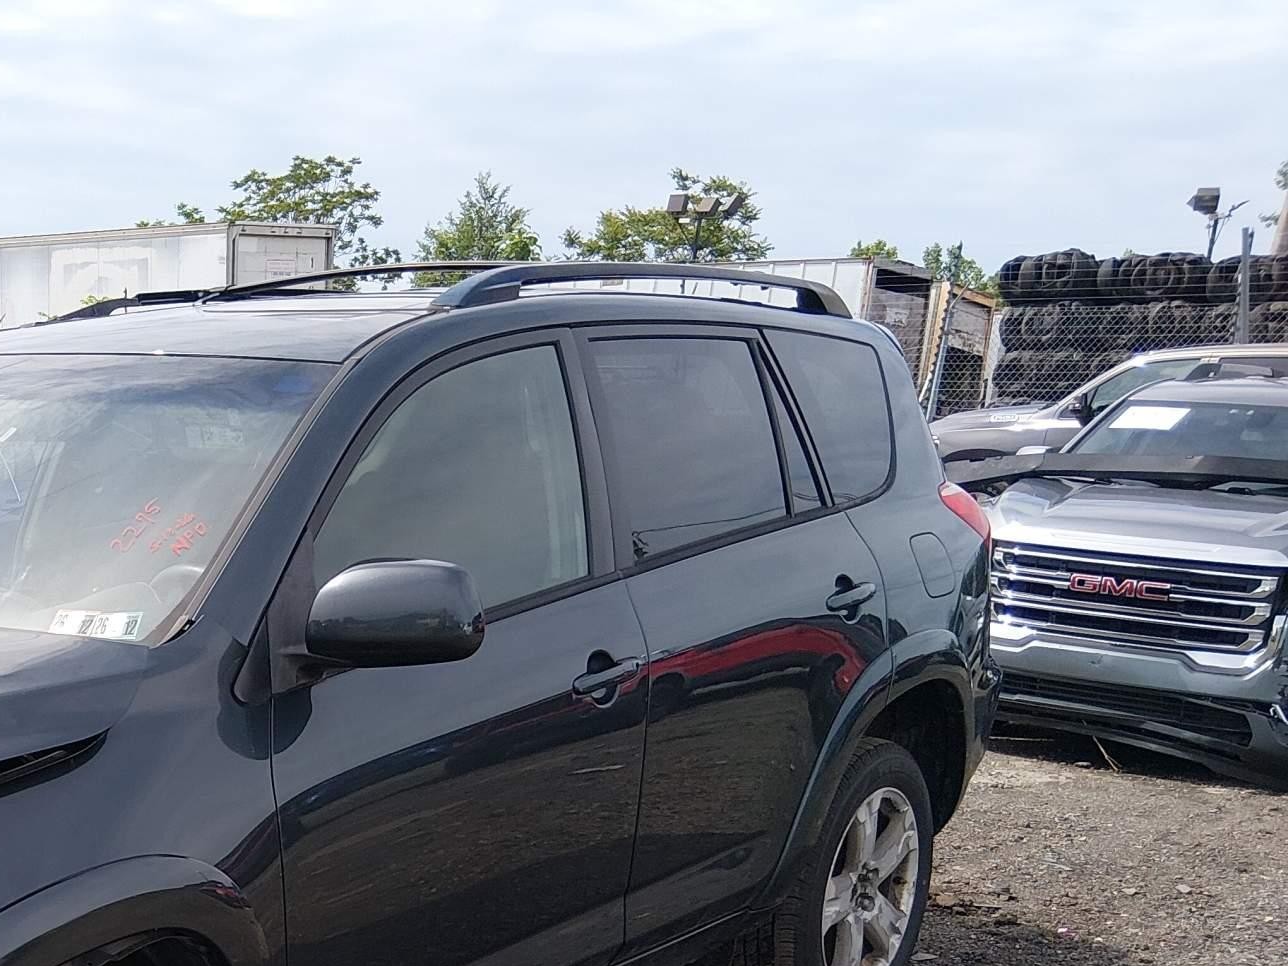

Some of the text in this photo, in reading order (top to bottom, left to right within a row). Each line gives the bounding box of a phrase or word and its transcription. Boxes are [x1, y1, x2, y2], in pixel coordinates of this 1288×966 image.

[1070, 573, 1171, 602] GMC
[93, 616, 139, 636] 26 12
